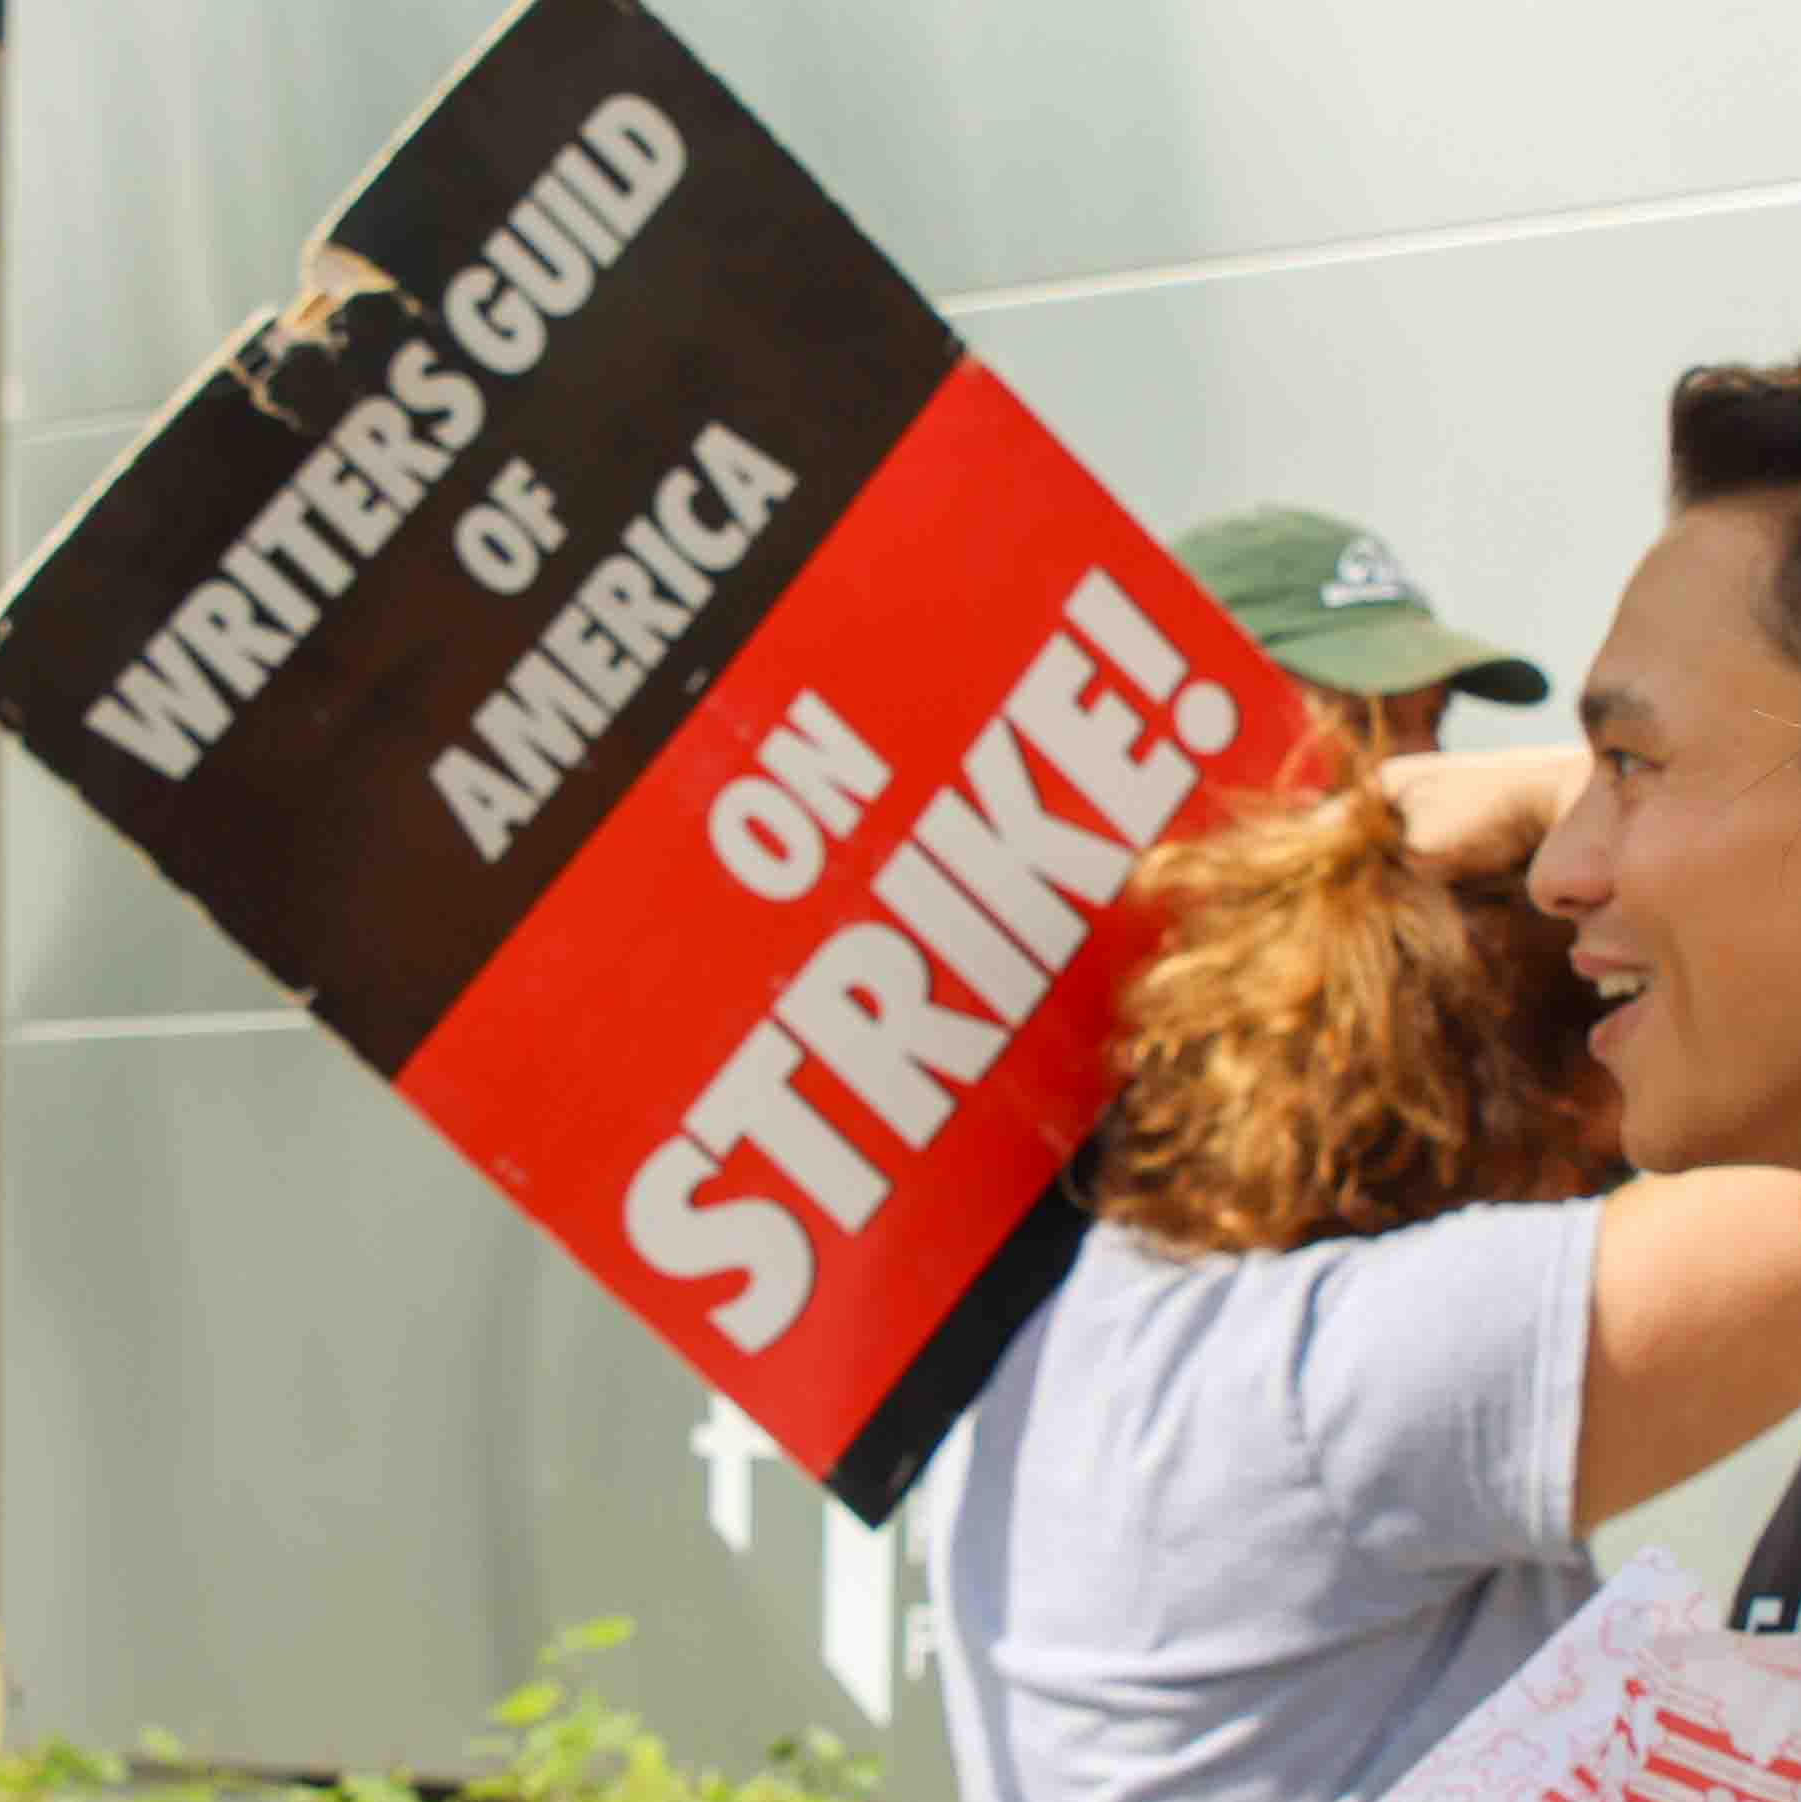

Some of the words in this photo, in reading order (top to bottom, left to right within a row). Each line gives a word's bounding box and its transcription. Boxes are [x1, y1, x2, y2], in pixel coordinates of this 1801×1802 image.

[84, 342, 486, 781] WRITERS
[444, 93, 688, 375] GUILD
[429, 421, 799, 862] AMERICA
[453, 458, 568, 595] OF
[622, 565, 1242, 1356] STRIKE!
[706, 688, 895, 902] ON
